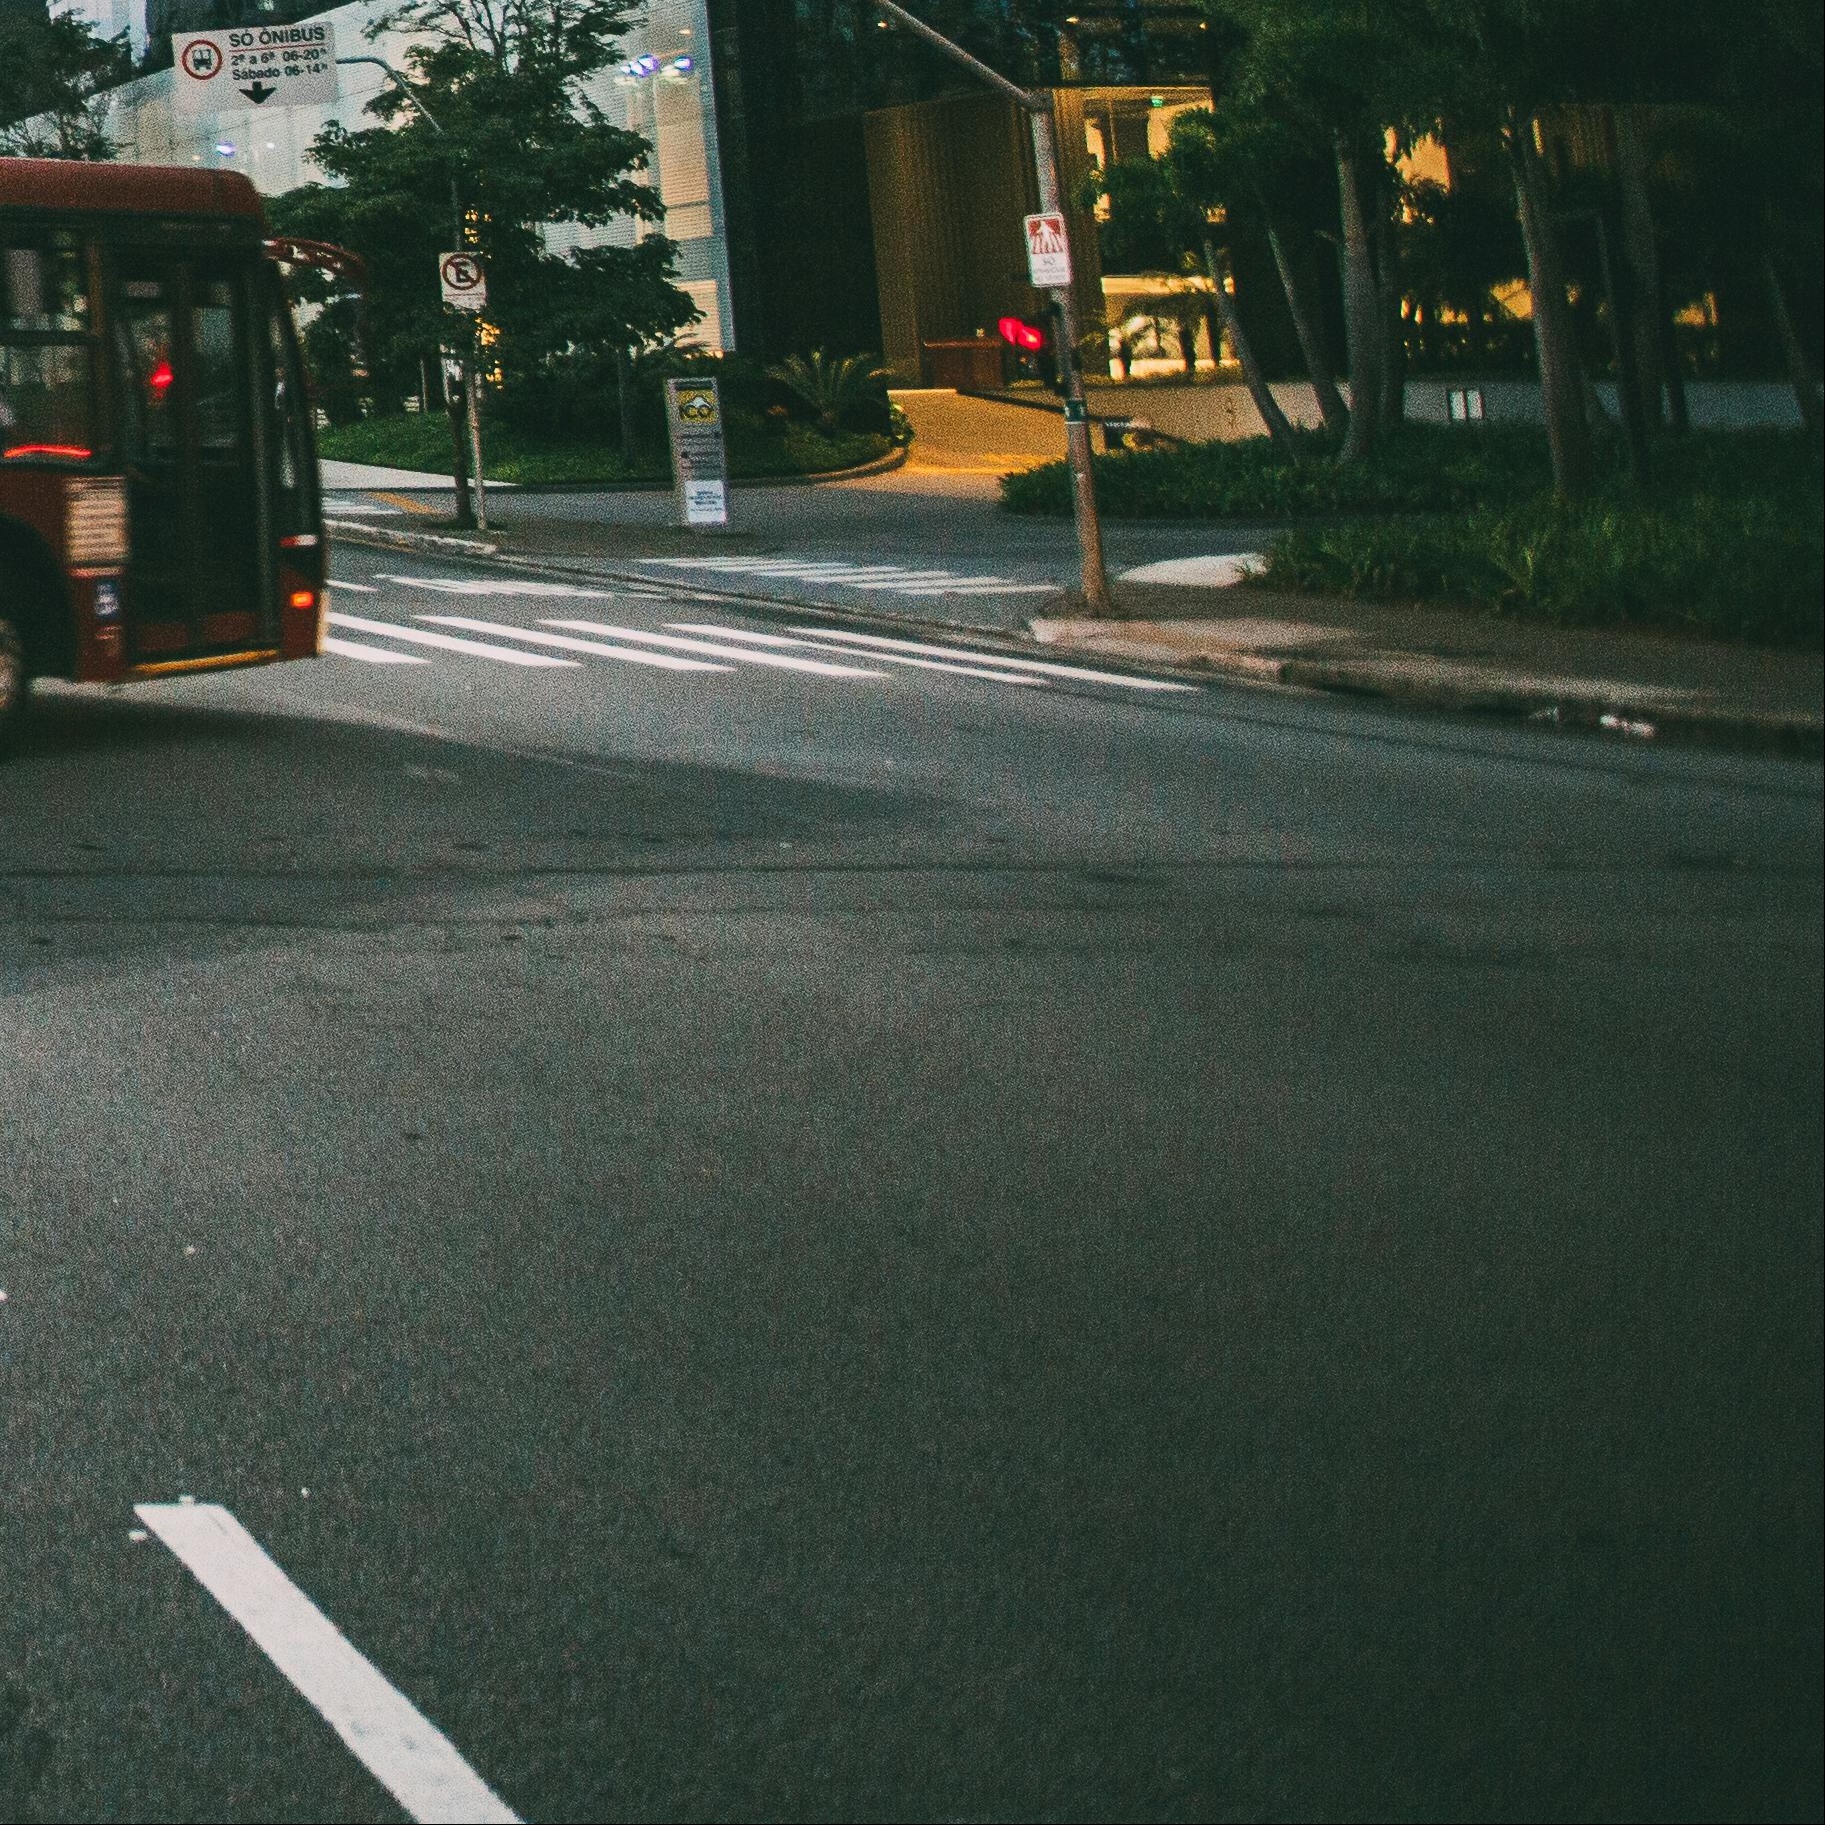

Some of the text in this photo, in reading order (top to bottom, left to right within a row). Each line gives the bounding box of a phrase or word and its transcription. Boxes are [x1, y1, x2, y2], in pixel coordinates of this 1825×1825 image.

[228, 25, 326, 48] SÓ ÔNIBUS
[249, 54, 258, 65] a
